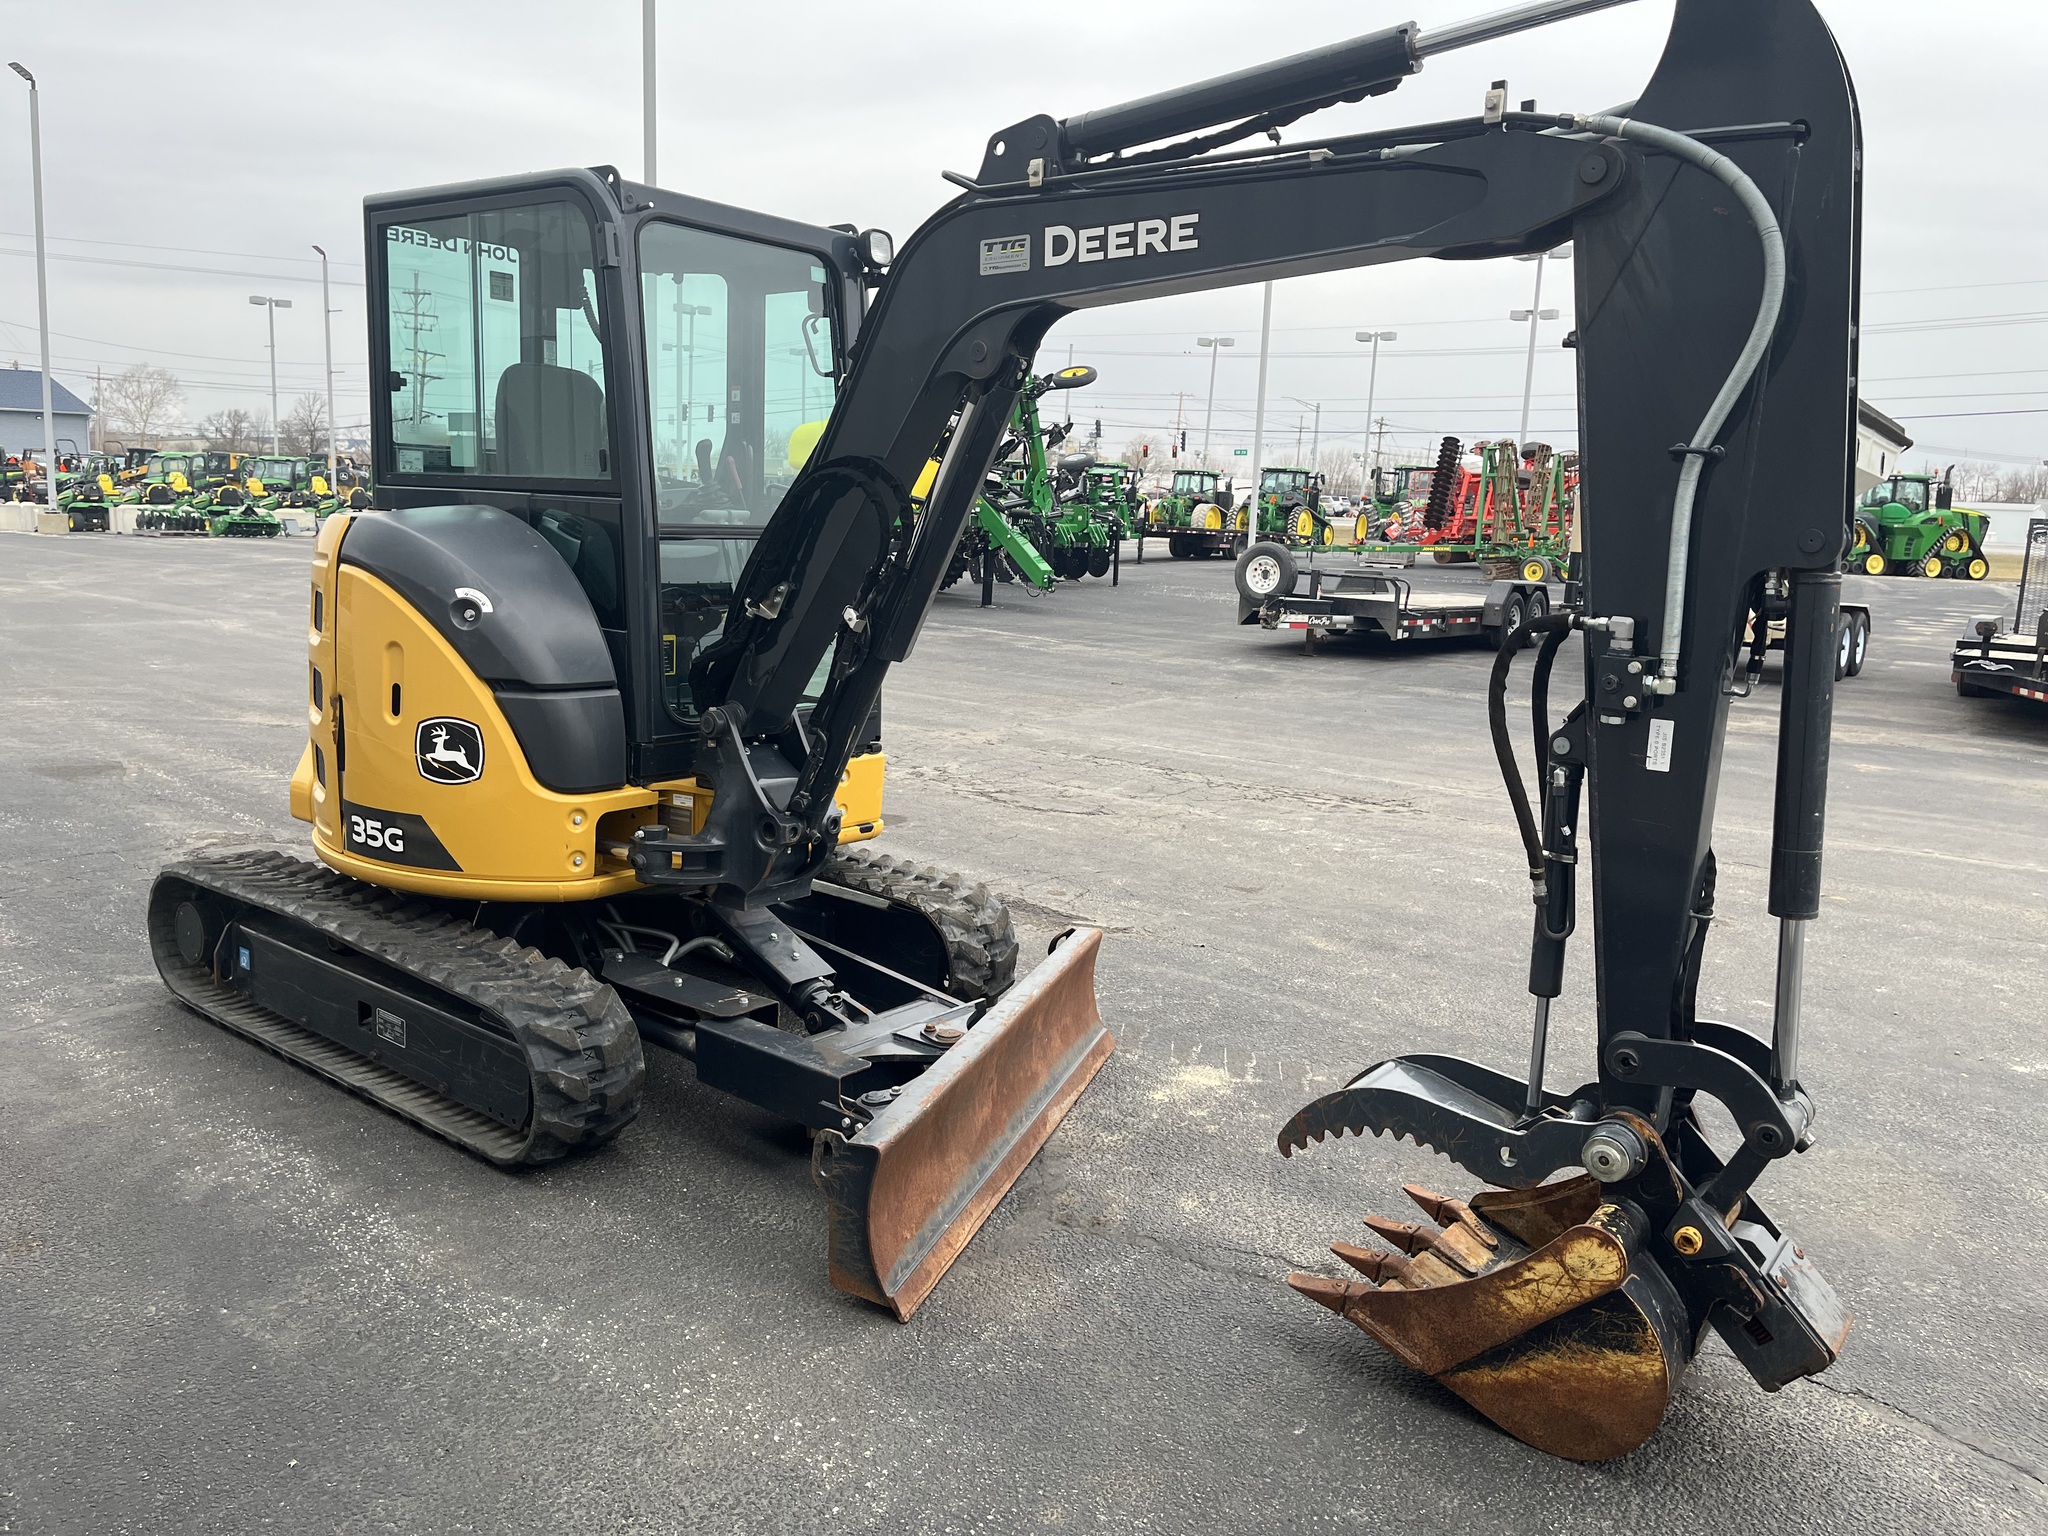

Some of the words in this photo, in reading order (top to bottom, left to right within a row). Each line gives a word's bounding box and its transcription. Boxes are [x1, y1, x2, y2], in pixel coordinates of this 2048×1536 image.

[984, 238, 1027, 255] TTG
[1044, 213, 1199, 267] DEERE
[985, 253, 1024, 261] EQUIPMENT
[351, 815, 404, 852] 35G
